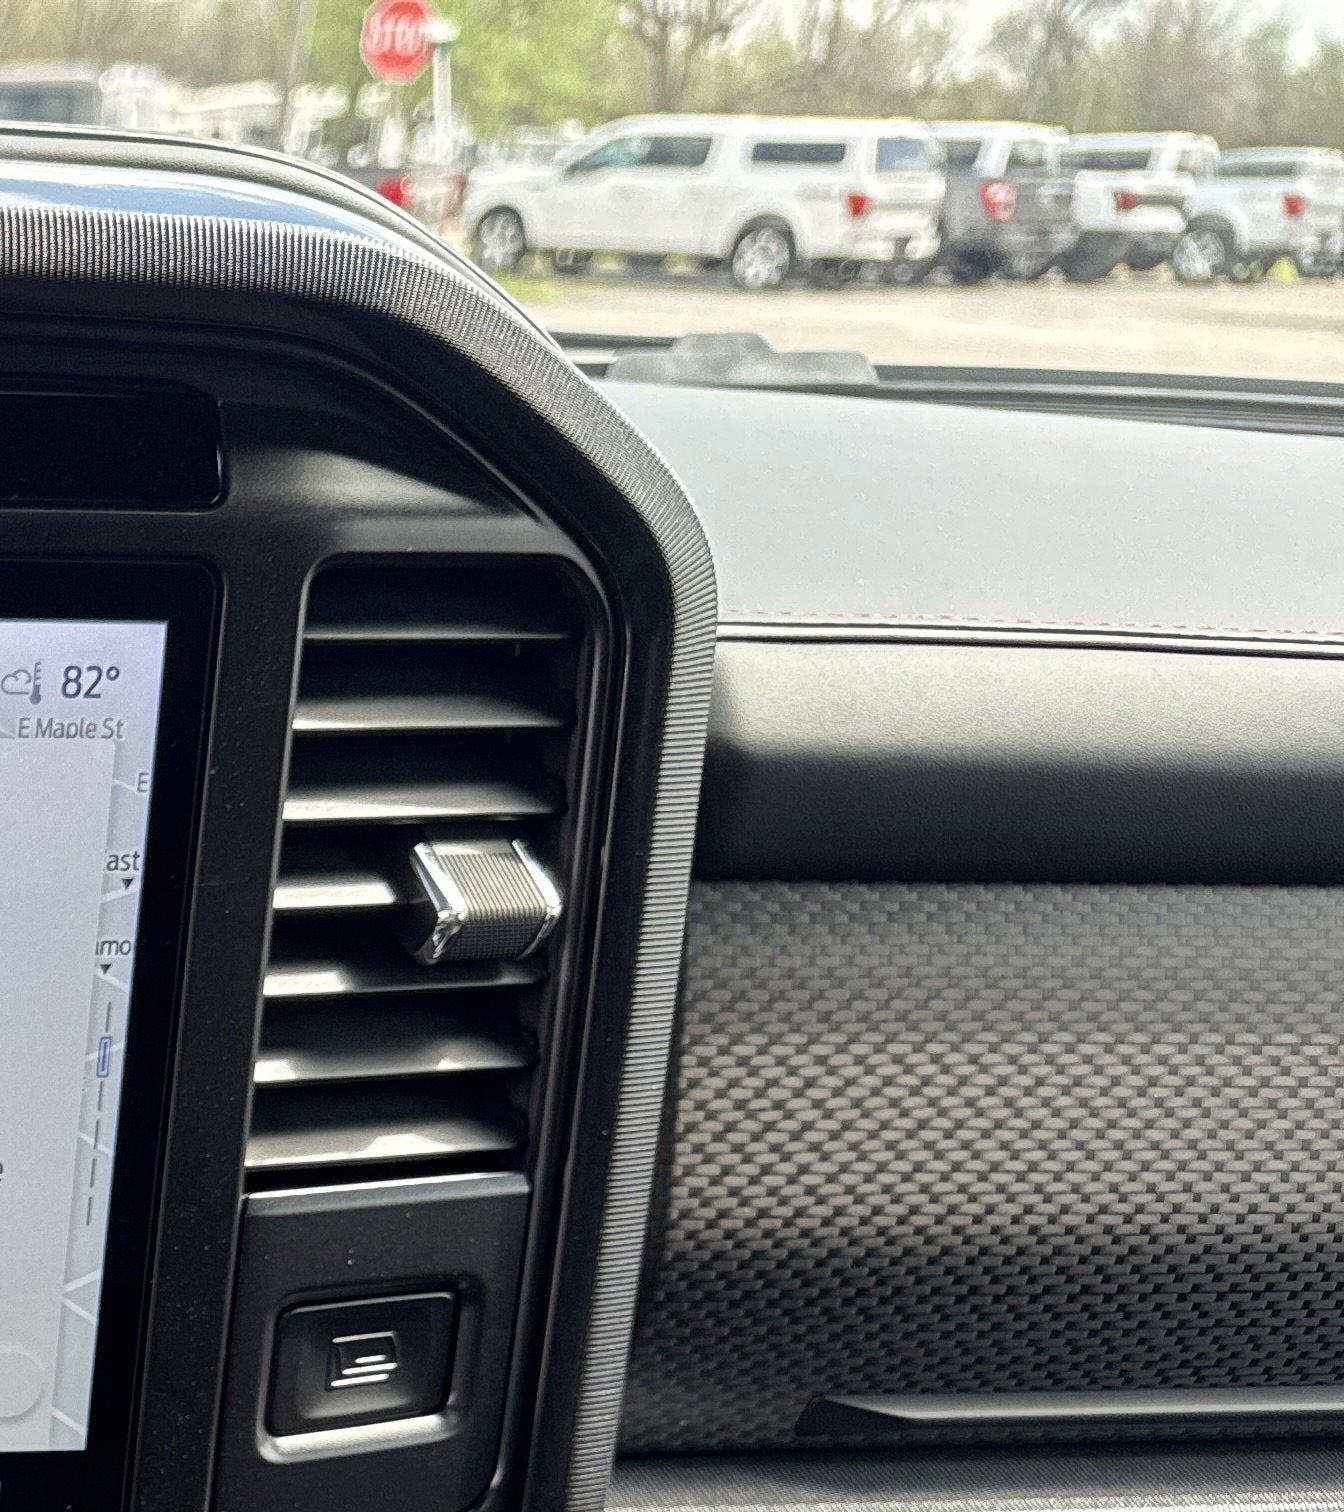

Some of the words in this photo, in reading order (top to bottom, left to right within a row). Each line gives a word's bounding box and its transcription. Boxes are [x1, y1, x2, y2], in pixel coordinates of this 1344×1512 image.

[61, 665, 120, 699] 82°
[18, 717, 31, 738] E
[35, 717, 97, 738] Maple
[101, 717, 124, 739] St
